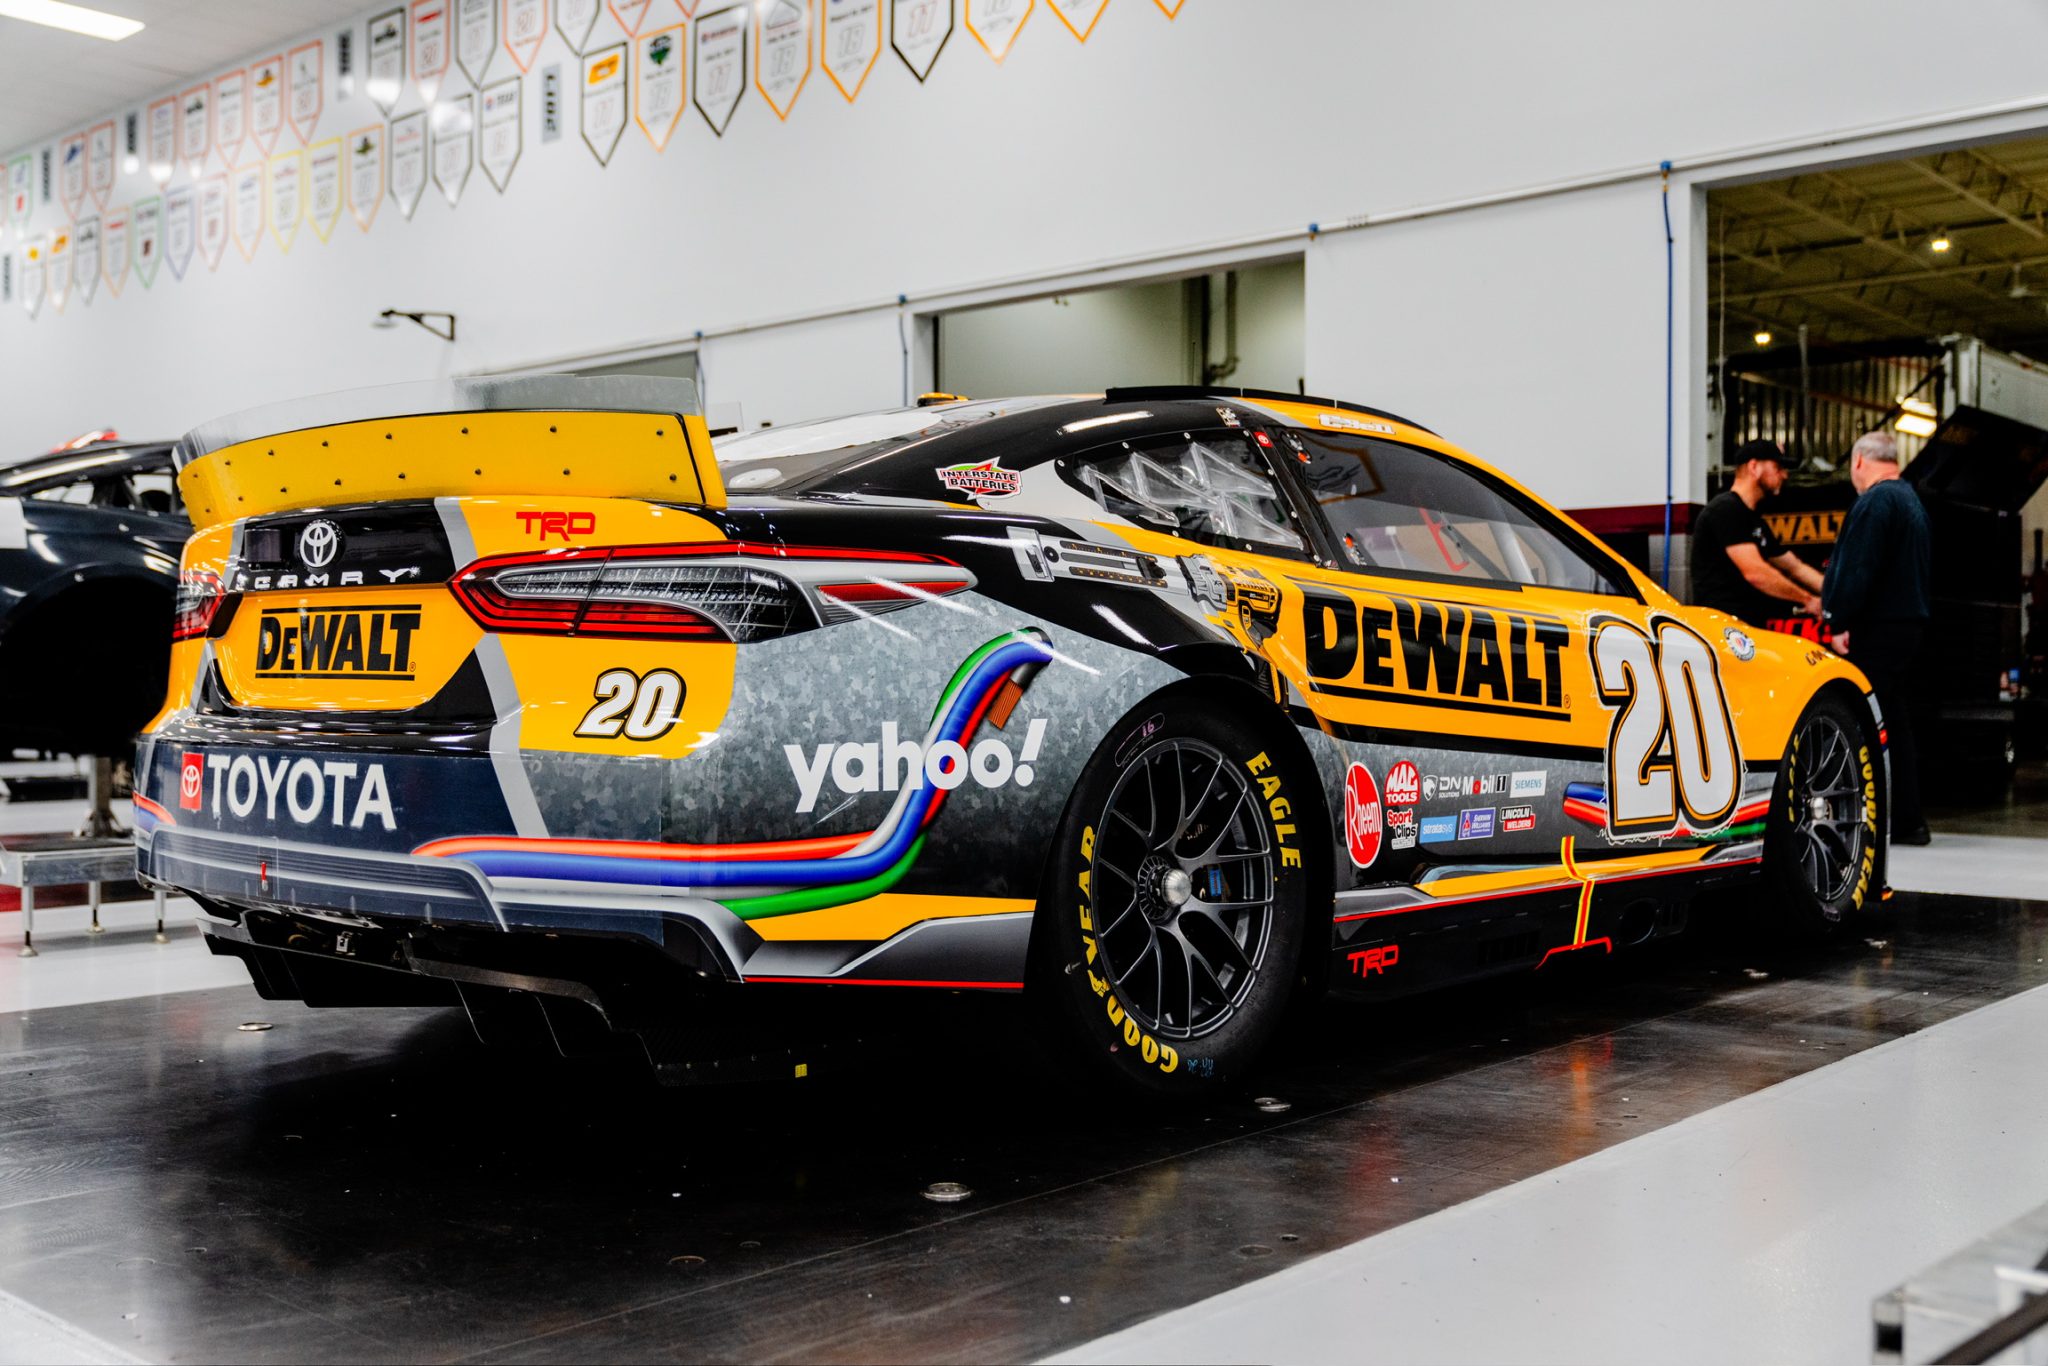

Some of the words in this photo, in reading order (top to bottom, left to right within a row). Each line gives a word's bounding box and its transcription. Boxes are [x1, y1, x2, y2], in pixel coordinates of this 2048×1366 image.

[942, 470, 1017, 482] INTERSTATE
[951, 478, 1016, 491] BATTERIES
[516, 511, 596, 542] TRD
[254, 568, 411, 590] CAMRY
[573, 667, 687, 742] 20
[1588, 613, 1742, 839] 20
[783, 718, 1048, 813] yahoo!
[1386, 764, 1418, 793] MAG
[1439, 776, 1461, 791] DN
[1462, 774, 1495, 796] Mobil
[1514, 778, 1543, 790] SIEMENS
[208, 753, 397, 831] TOYOTA
[1386, 792, 1418, 804] TOOLS
[1246, 751, 1302, 869] EAGLE
[1347, 766, 1381, 851] Rheem
[1387, 808, 1412, 827] Sport
[1502, 807, 1530, 820] LINCOLN
[1395, 823, 1417, 839] Clips
[1506, 819, 1532, 830] WELDERS
[1079, 826, 1179, 1073] GOODYEAR
[1347, 944, 1399, 979] TRD
